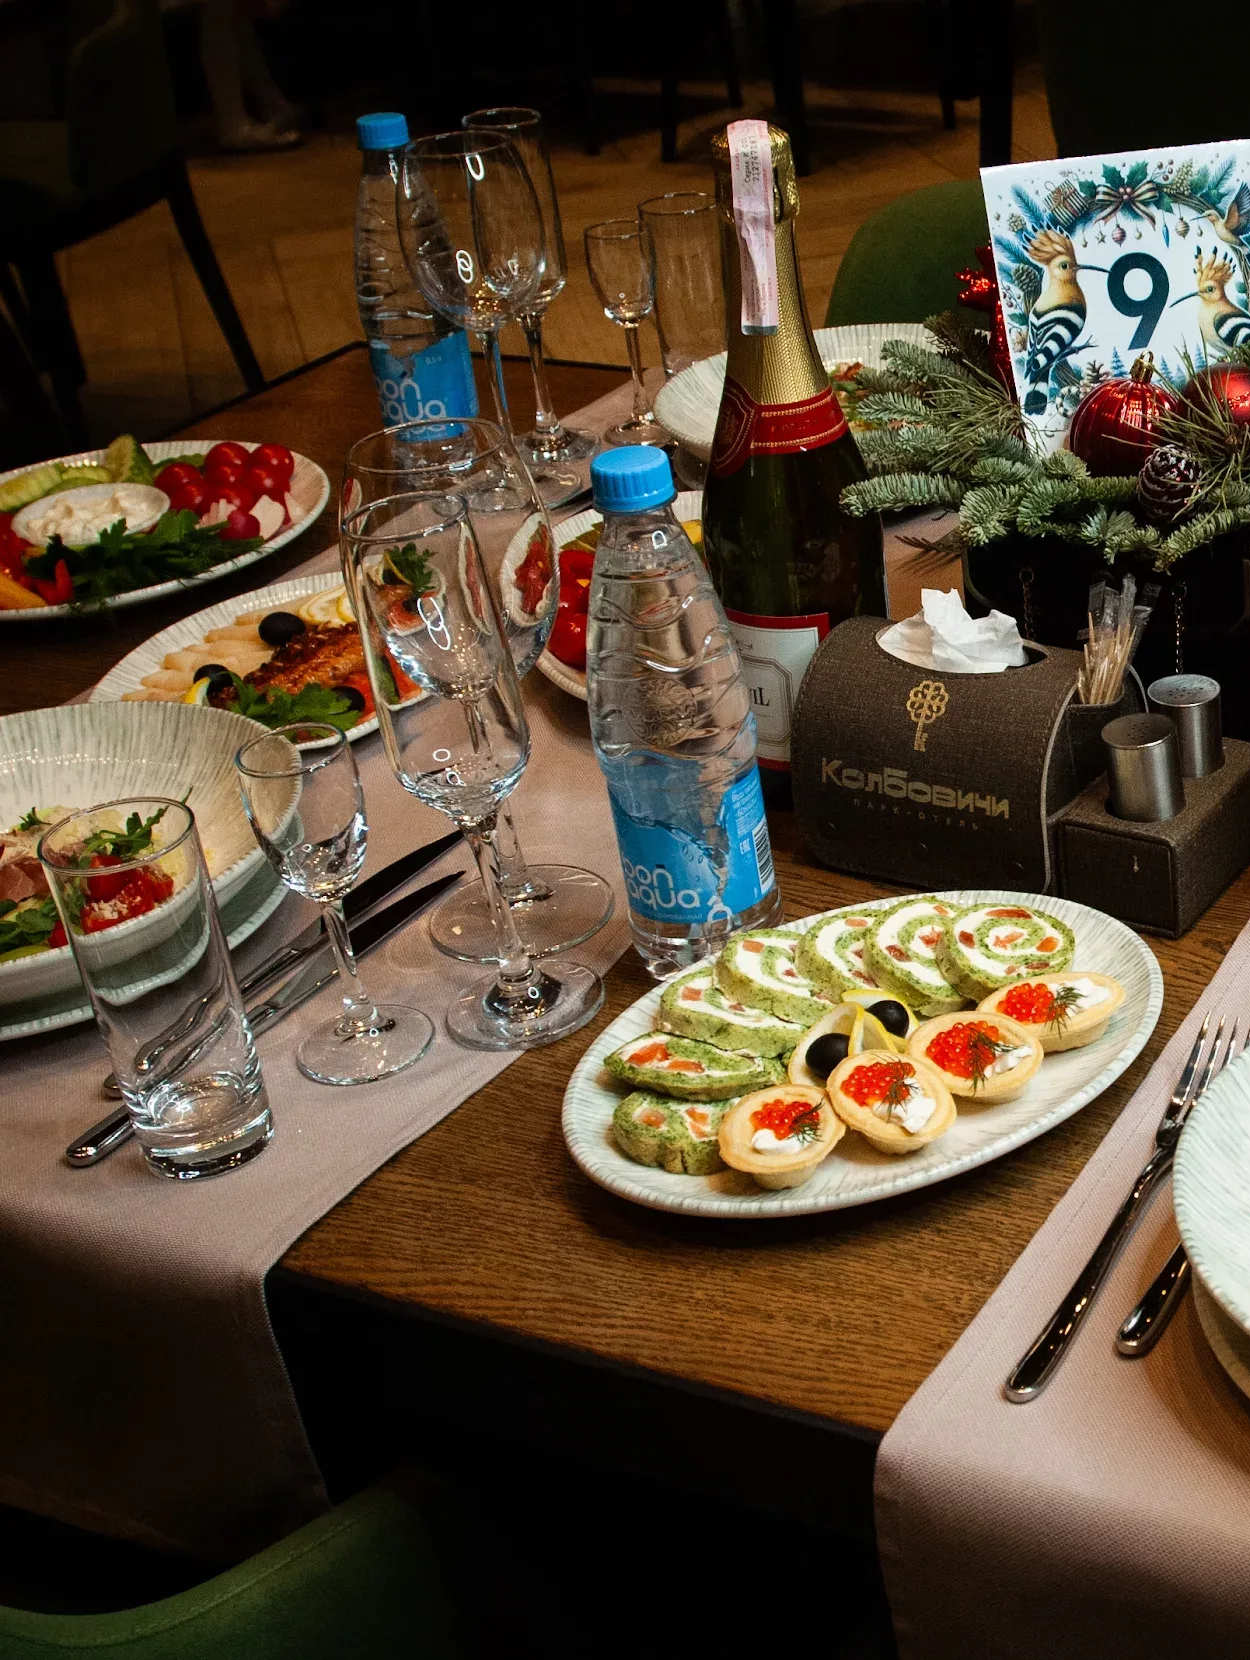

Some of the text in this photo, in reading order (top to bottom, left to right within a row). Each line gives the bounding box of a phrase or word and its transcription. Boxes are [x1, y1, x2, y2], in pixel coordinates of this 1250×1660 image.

[1107, 252, 1169, 351] 9
[821, 757, 1010, 820] Колбовичи
[626, 876, 701, 911] aqua
